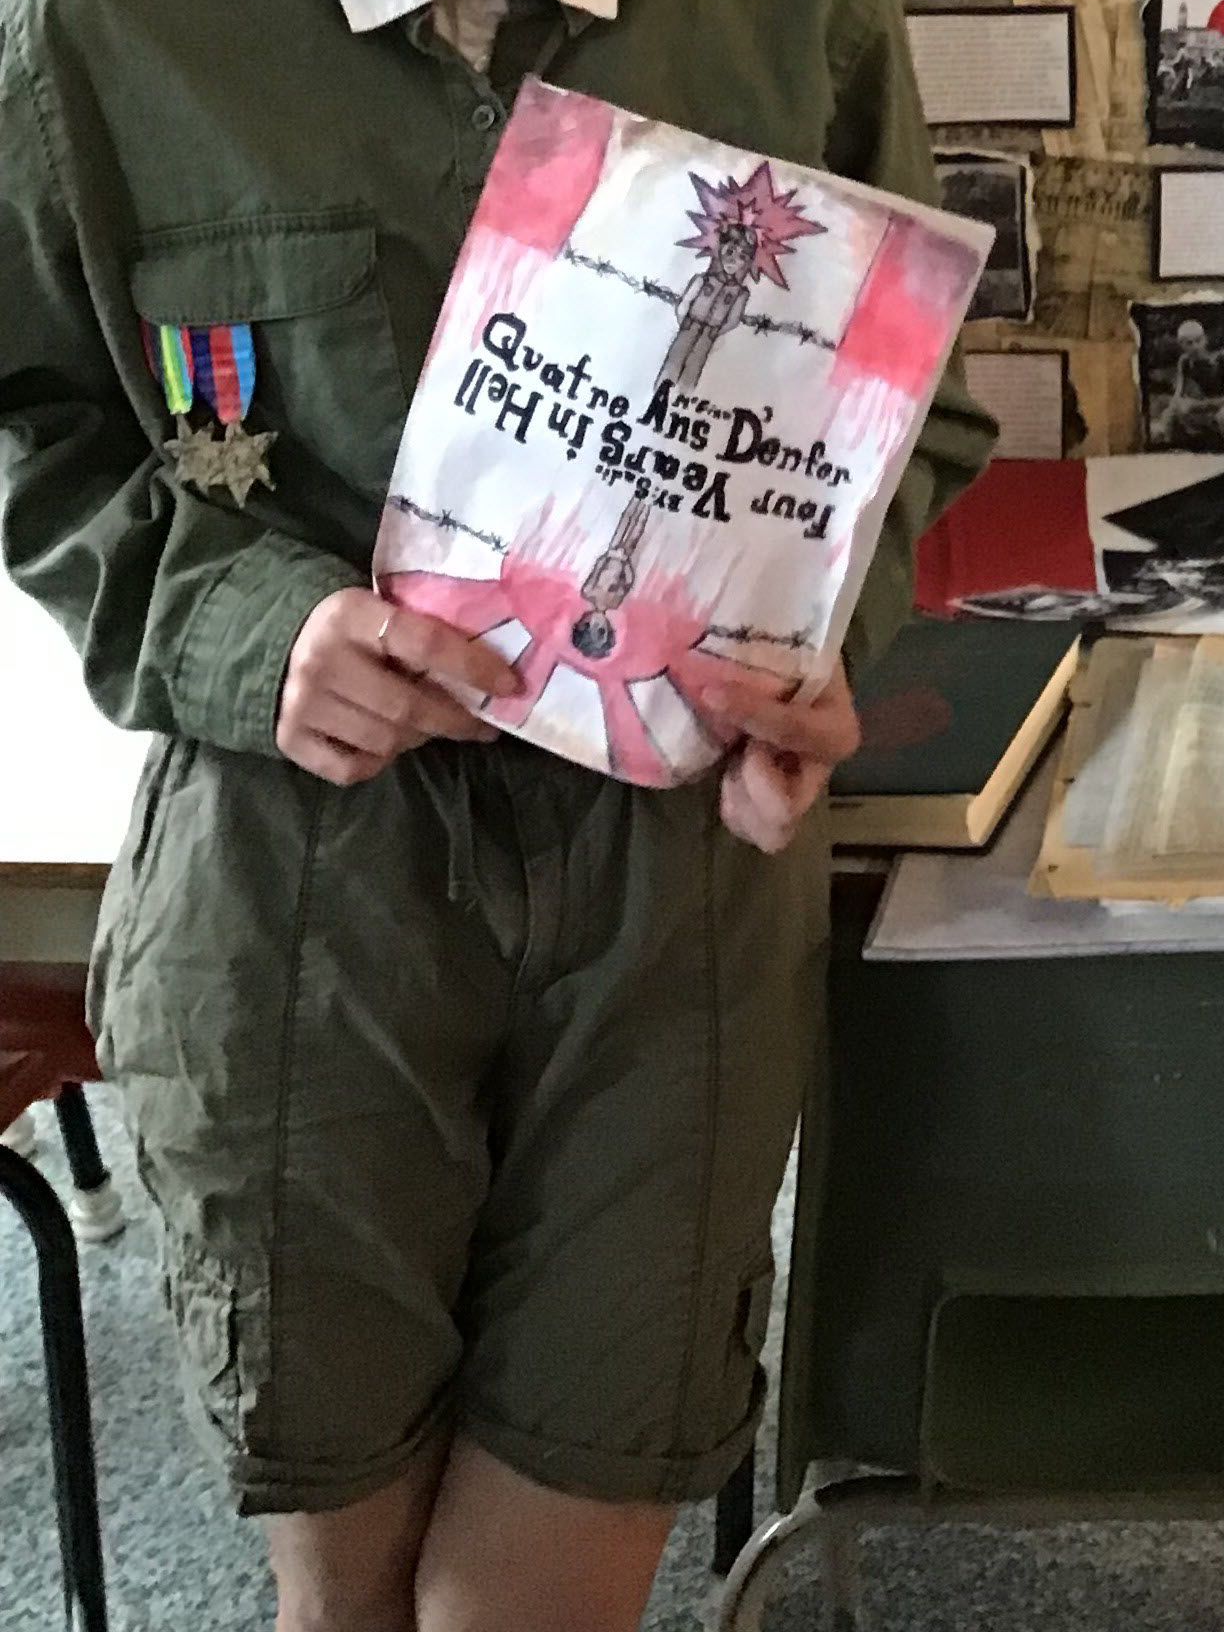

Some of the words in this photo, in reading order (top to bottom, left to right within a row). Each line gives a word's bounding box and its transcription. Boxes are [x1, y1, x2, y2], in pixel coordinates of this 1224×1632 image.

[454, 359, 544, 445] Hell
[482, 312, 630, 420] Quatre
[638, 378, 711, 452] Ans
[750, 488, 836, 540] Four
